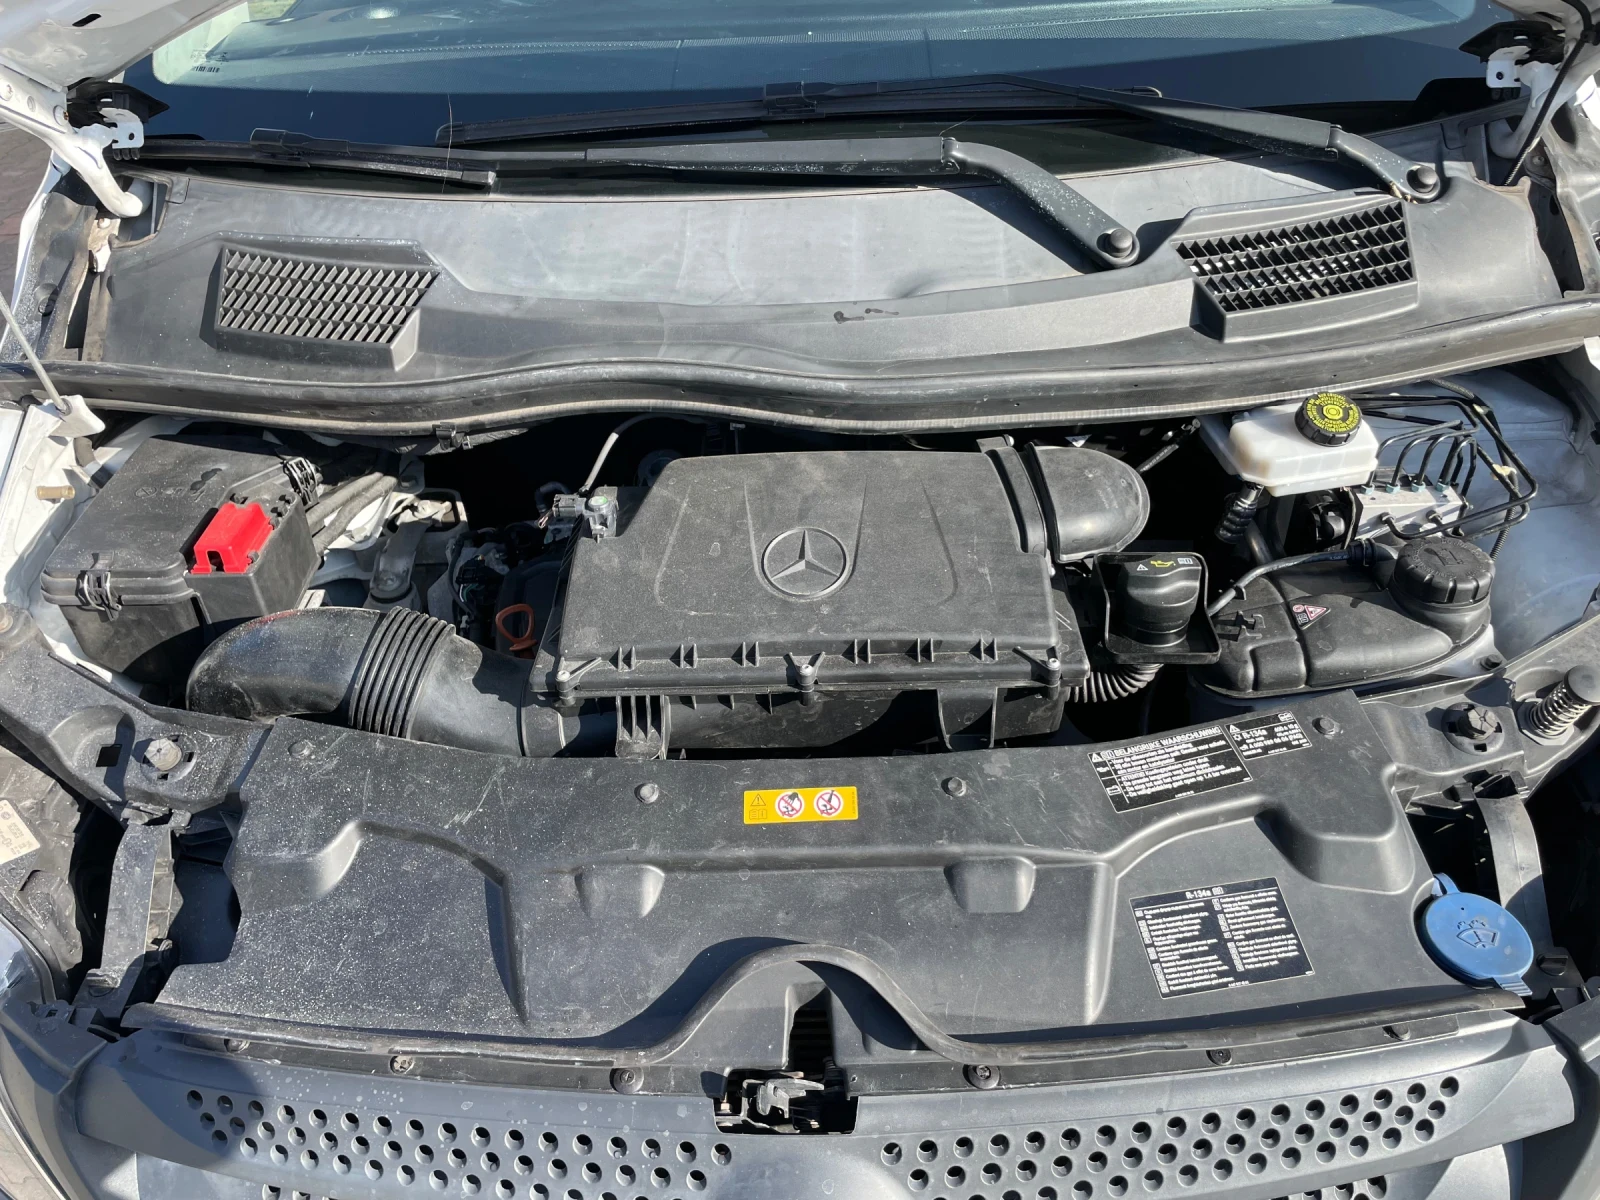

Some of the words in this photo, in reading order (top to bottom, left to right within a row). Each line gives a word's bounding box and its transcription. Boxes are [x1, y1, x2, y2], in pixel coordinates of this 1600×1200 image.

[1160, 726, 1221, 746] WAARSCHUWING
[1242, 729, 1268, 739] R-134a
[1185, 889, 1212, 900] R-134a
